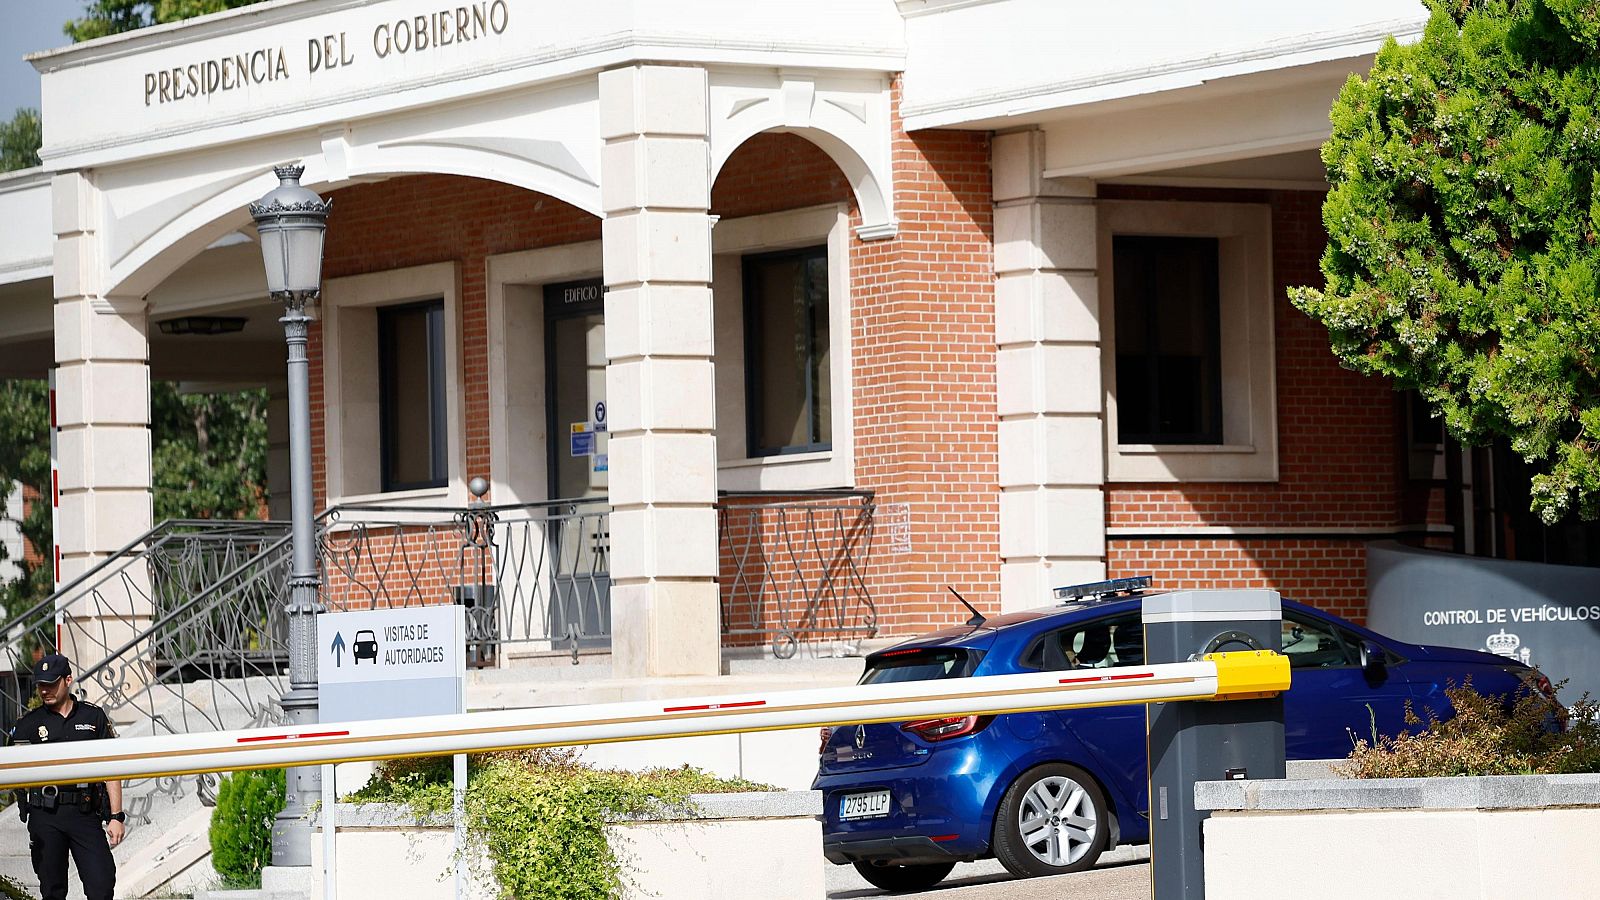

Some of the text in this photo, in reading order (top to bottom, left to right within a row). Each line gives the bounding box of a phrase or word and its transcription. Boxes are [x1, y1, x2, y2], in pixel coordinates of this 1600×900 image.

[145, 0, 509, 106] PRESIDENCIA DEL GOBIERNO
[564, 286, 597, 303] EDIFICIO
[1424, 604, 1600, 626] CONTROL DE VEHÍCULOS
[384, 623, 429, 642] VISITAS DE
[384, 646, 444, 665] AUTORIDADES
[845, 793, 887, 814] 2795 LLP
